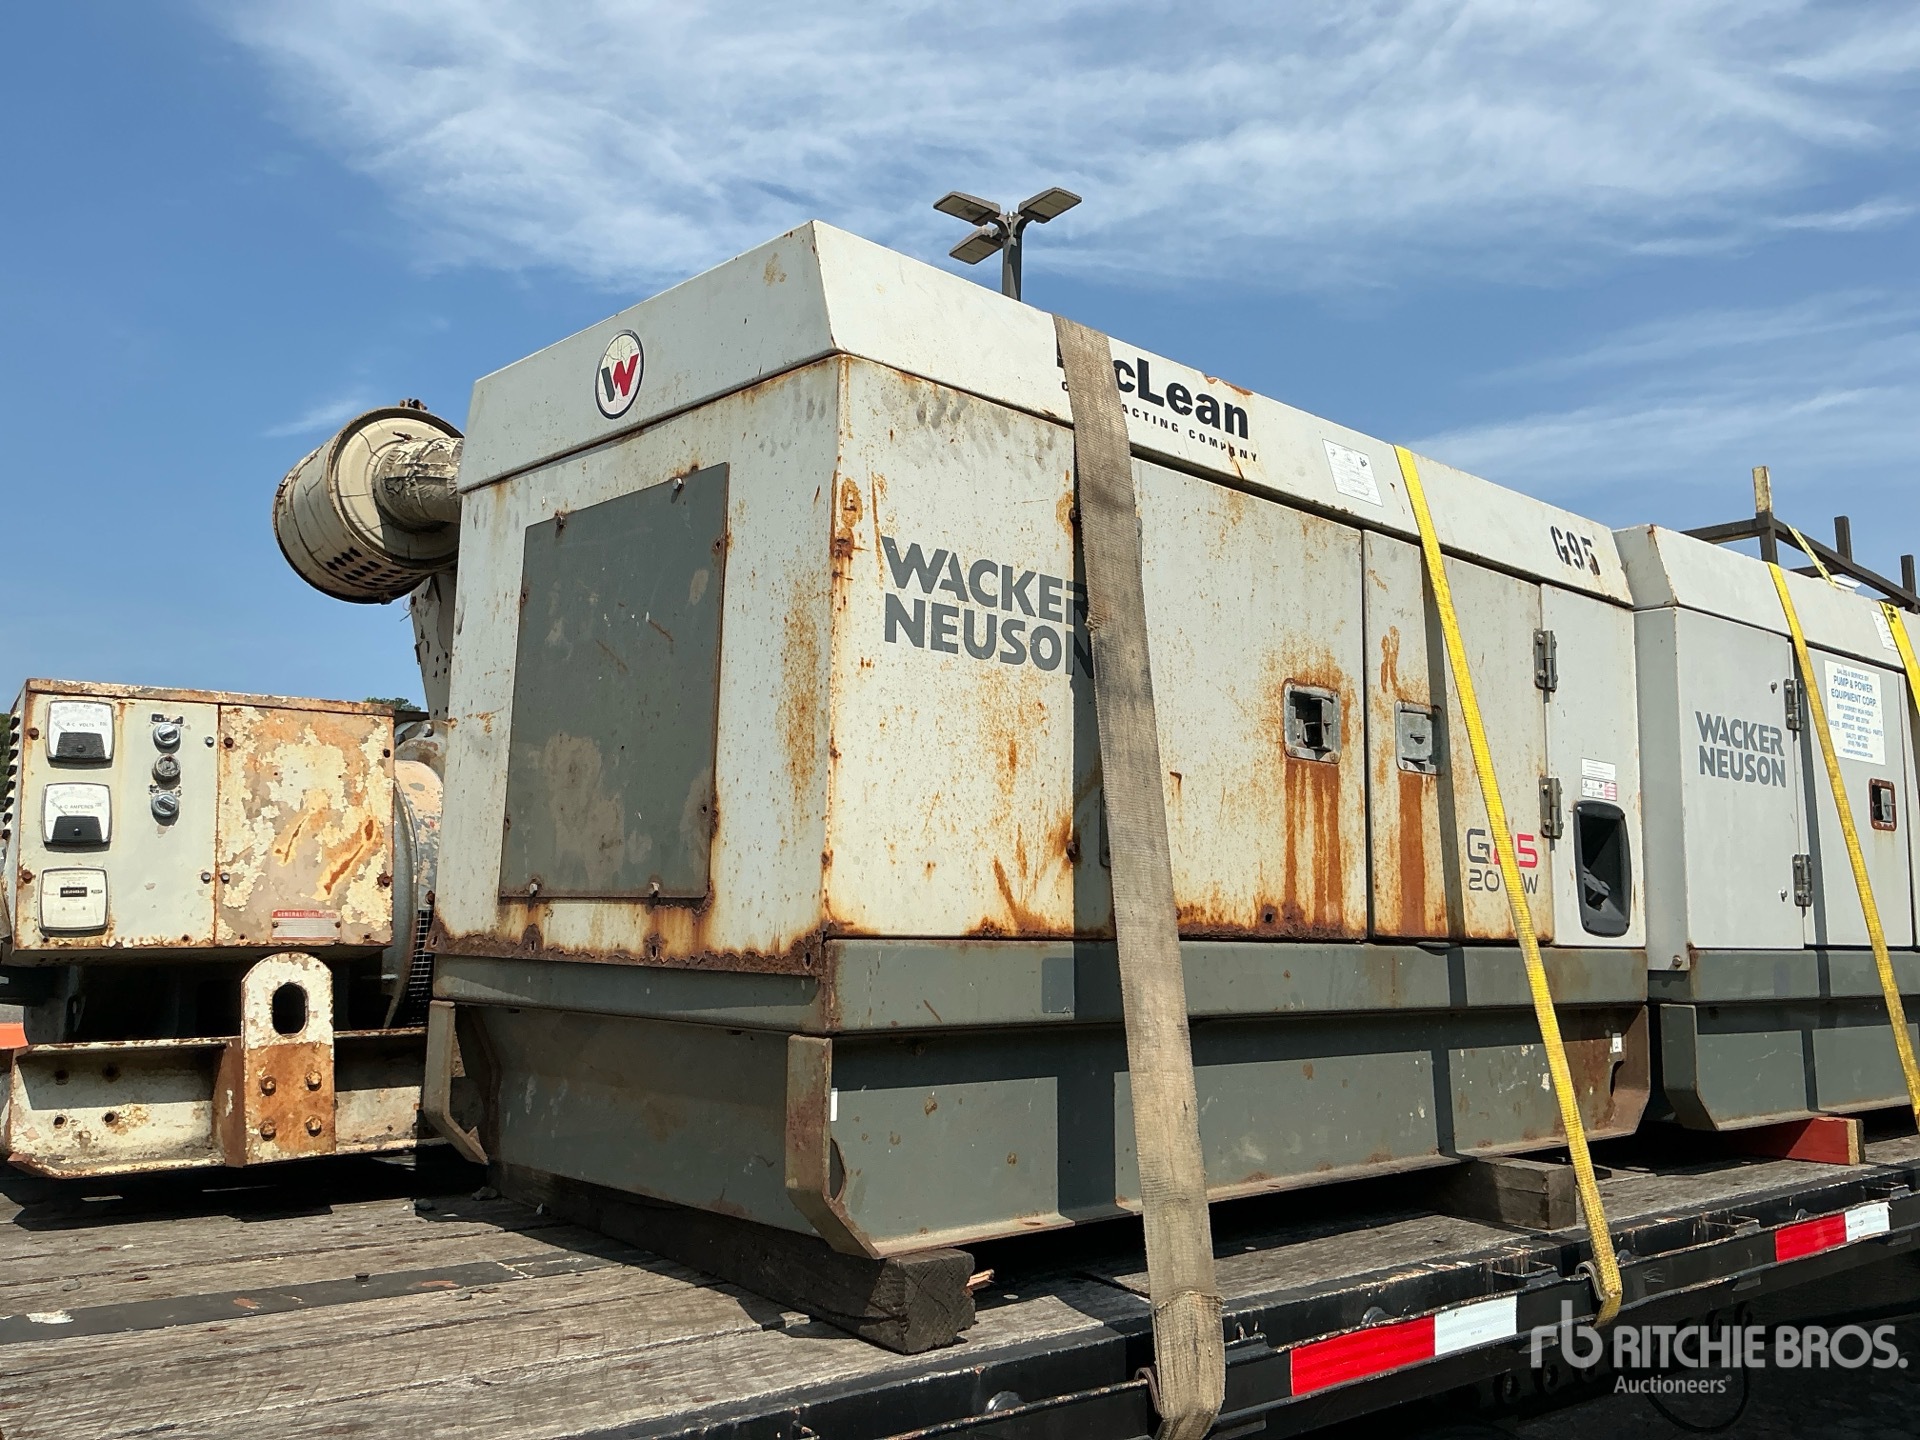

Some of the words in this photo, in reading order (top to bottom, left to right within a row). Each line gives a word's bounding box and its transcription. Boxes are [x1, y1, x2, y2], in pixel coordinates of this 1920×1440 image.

[1057, 341, 1249, 440] cLean
[1550, 525, 1601, 576] G95
[884, 592, 1095, 680] NEUSON
[1831, 688, 1862, 704] EQUIPMENT
[1833, 675, 1849, 688] PUMP
[1849, 681, 1854, 690] &
[1854, 681, 1873, 693] POWER
[1695, 711, 1785, 757] WACKER
[1699, 745, 1787, 788] NEUSON
[1468, 869, 1539, 895] 20W
